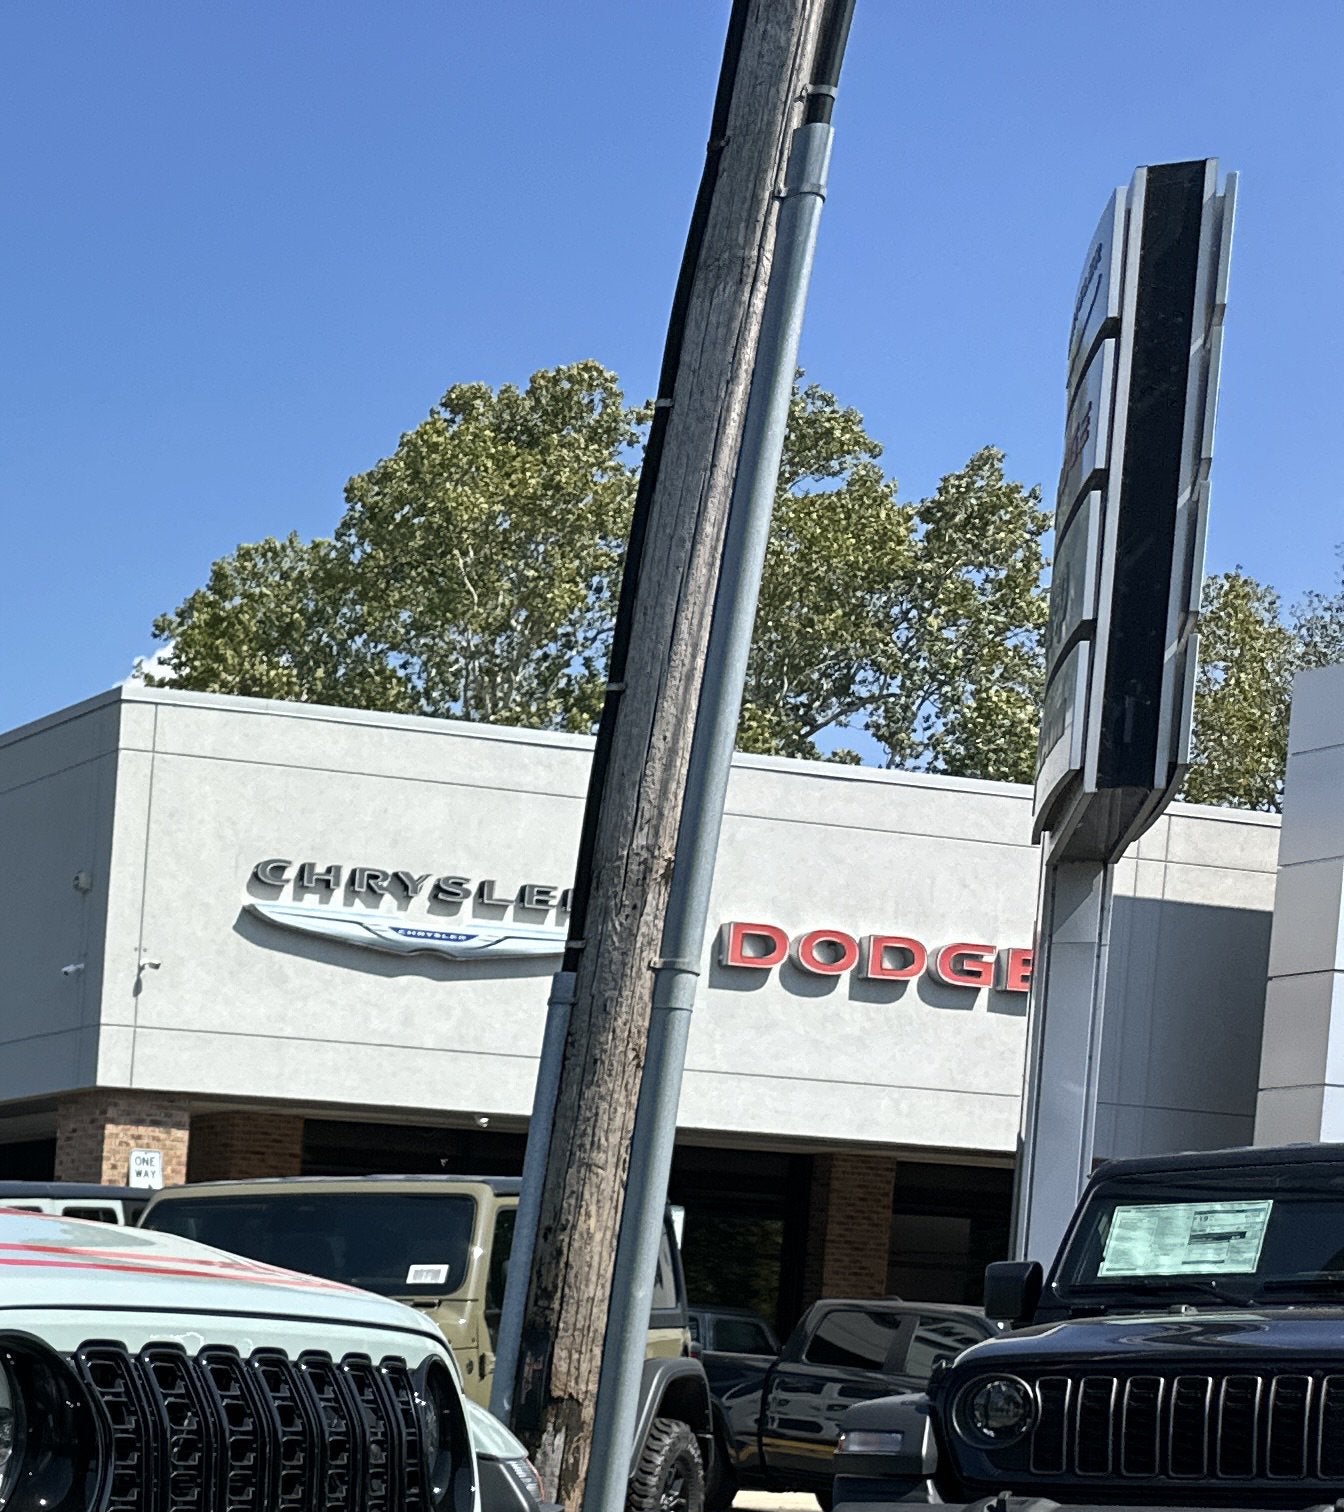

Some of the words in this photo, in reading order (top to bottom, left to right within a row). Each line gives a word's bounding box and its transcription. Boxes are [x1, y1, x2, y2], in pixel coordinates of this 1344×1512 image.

[255, 858, 572, 912] CHRYSLE
[134, 1156, 155, 1167] ONE
[135, 1169, 156, 1178] WAY
